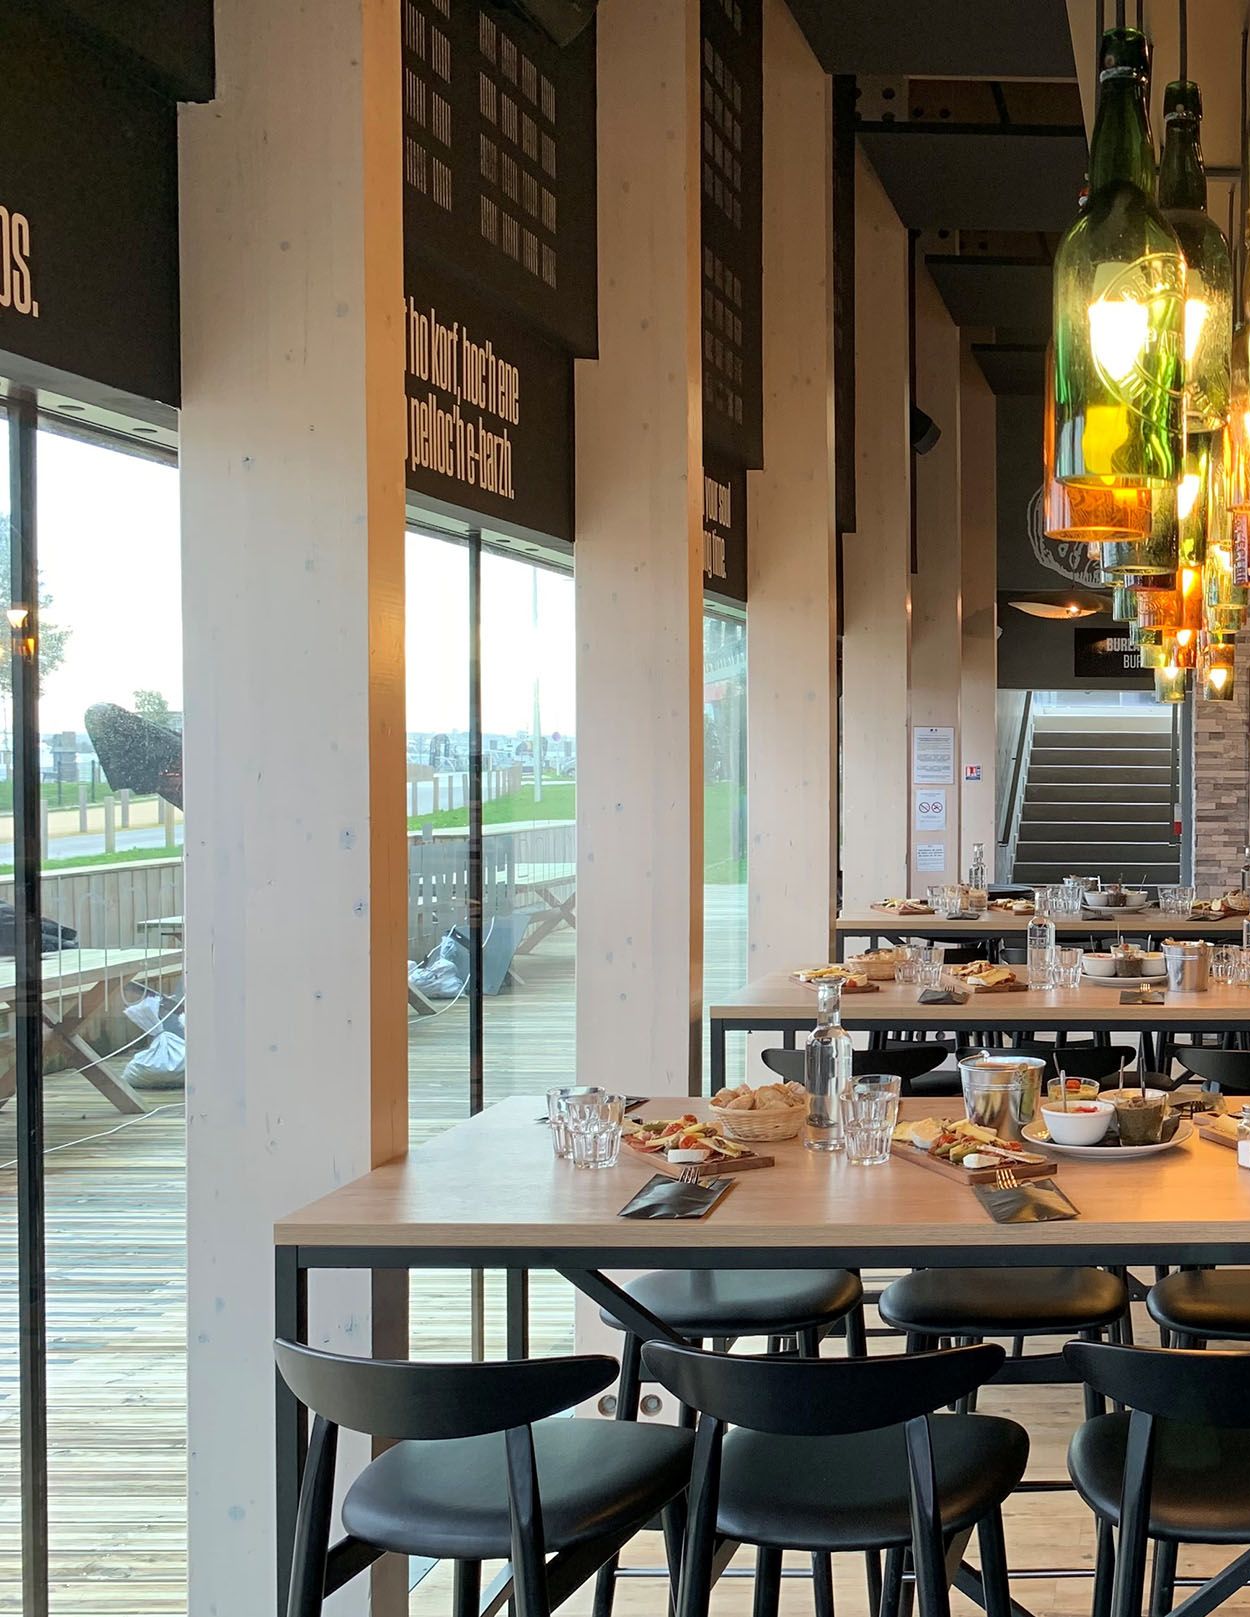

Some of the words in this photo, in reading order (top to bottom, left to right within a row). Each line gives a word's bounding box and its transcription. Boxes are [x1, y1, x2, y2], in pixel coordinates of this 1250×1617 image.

[410, 295, 429, 381] ho
[431, 308, 460, 405] korf,
[463, 326, 496, 414] hoc'h
[498, 358, 519, 425] ene
[719, 481, 731, 528] soul
